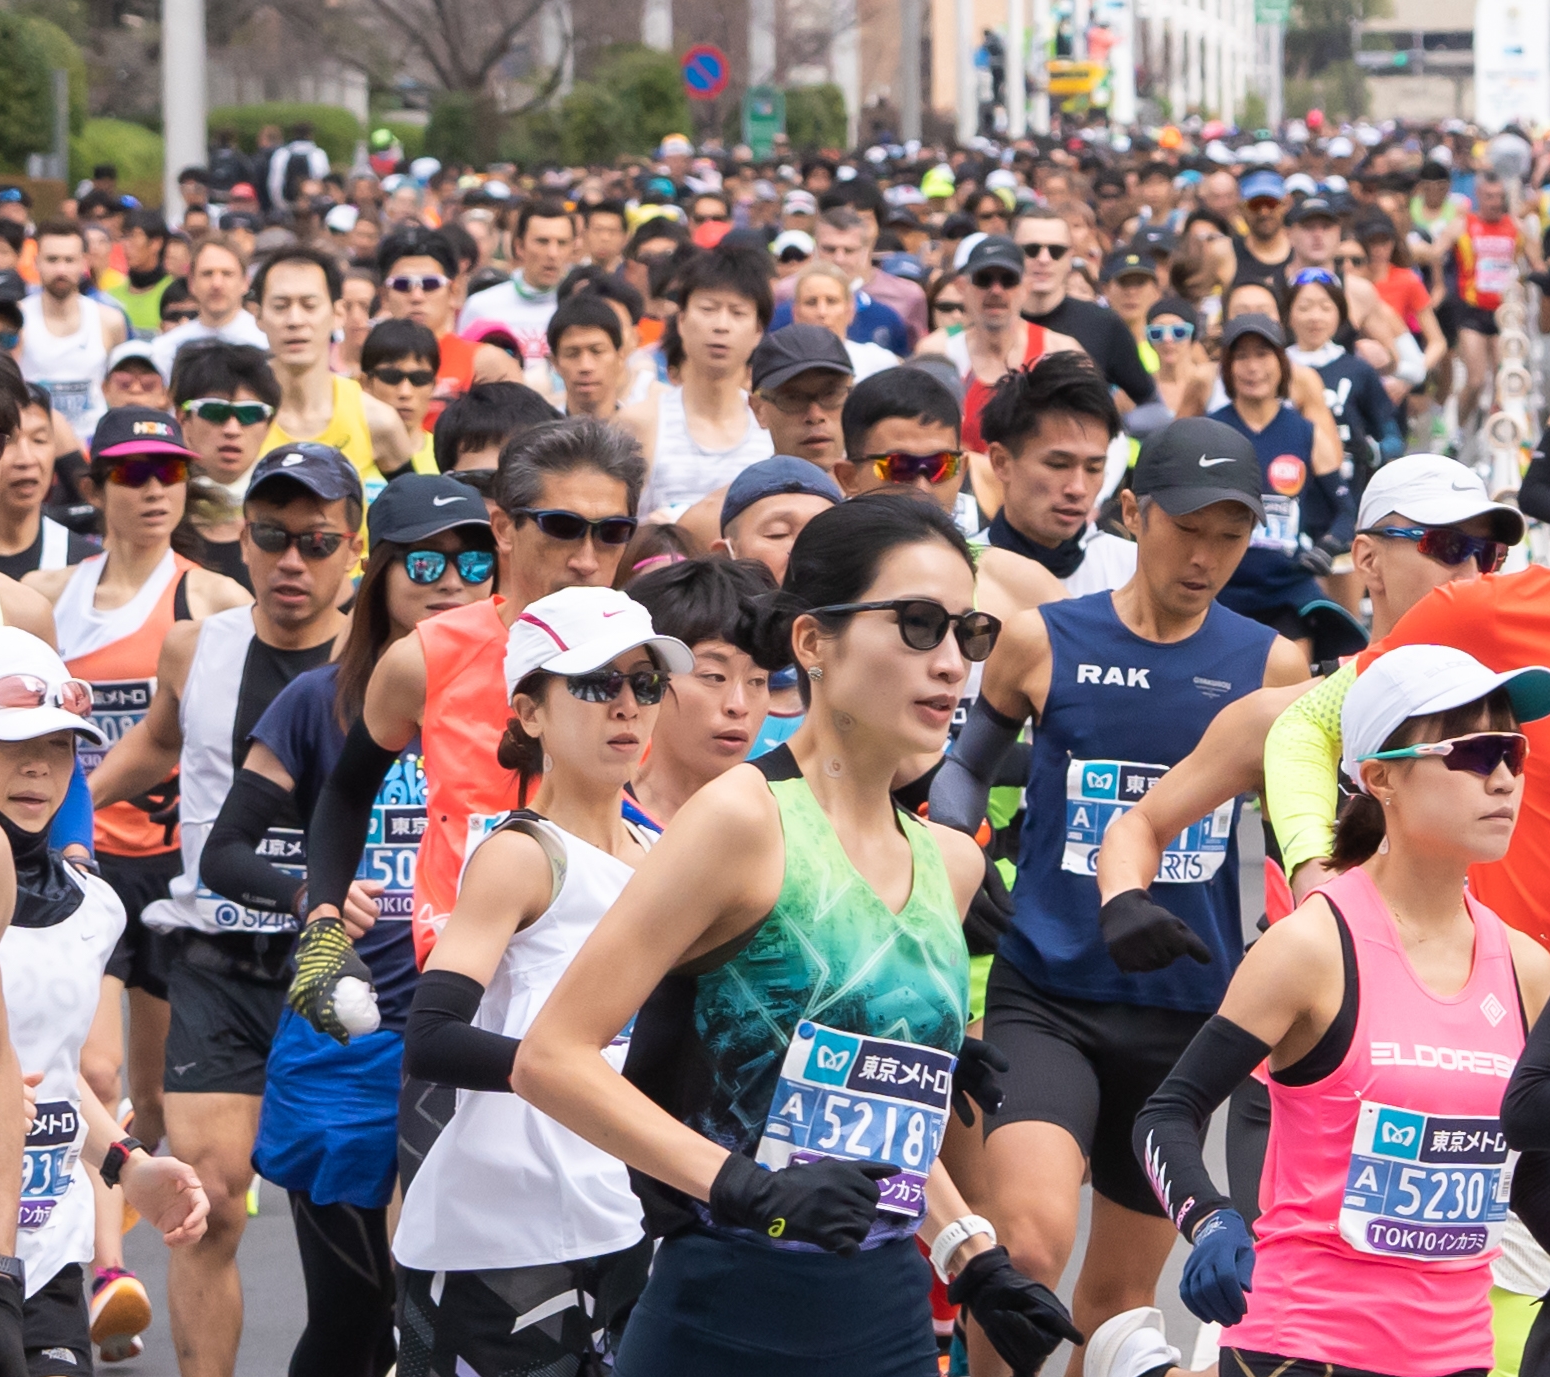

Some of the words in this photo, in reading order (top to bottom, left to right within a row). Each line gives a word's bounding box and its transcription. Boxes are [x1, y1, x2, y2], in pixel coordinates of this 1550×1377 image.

[1077, 663, 1150, 689] RAK
[95, 689, 148, 706] メトロ
[1072, 807, 1091, 828] A
[858, 1053, 948, 1094] 東京メトロ
[1371, 1041, 1516, 1081] ELDORES
[29, 1112, 75, 1135] メトロ
[779, 1091, 804, 1121] A
[818, 1094, 925, 1166] 5218
[1430, 1130, 1506, 1154] 東京メトロ
[1354, 1164, 1377, 1192] A
[1394, 1168, 1484, 1220] 5230
